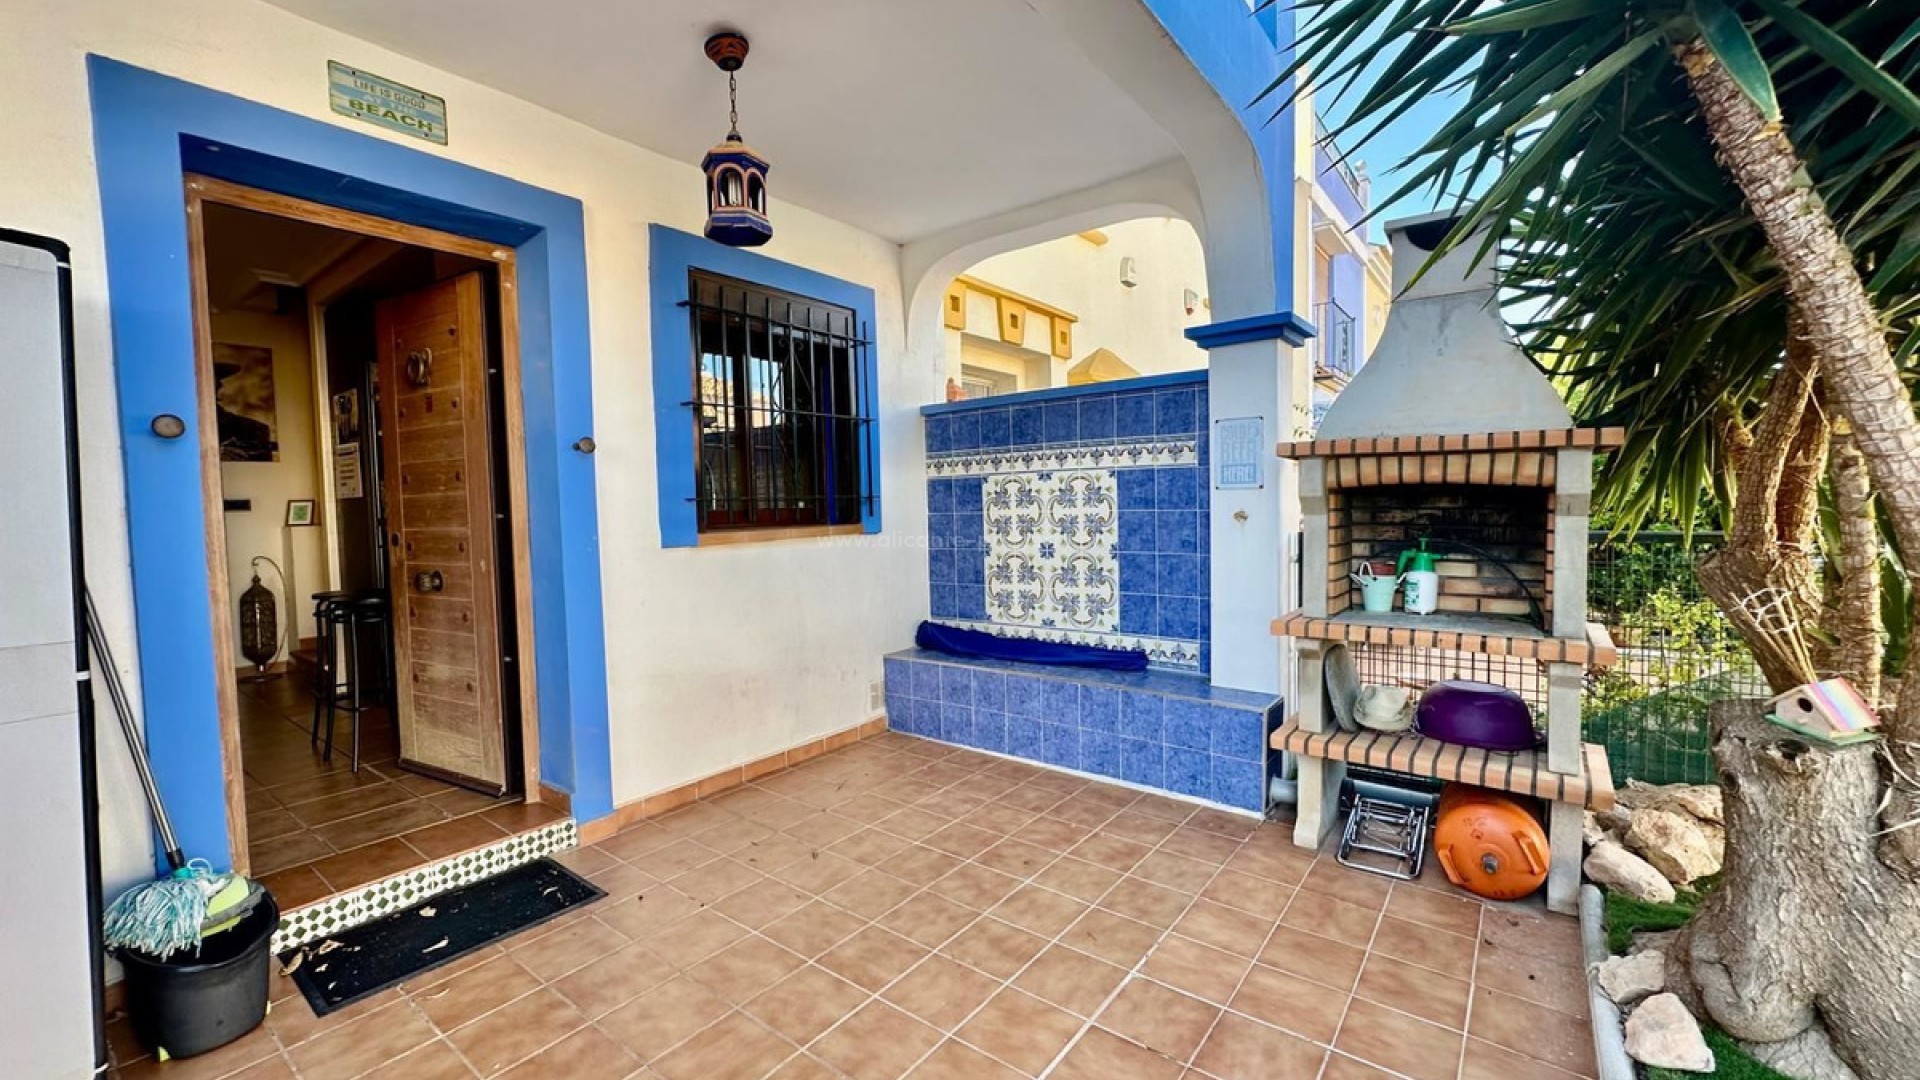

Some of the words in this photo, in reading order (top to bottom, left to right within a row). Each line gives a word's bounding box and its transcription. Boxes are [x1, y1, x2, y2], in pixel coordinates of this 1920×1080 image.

[353, 79, 377, 93] LIFE
[380, 88, 391, 98] IS
[394, 92, 425, 109] GOOD
[348, 99, 433, 133] BEACH
